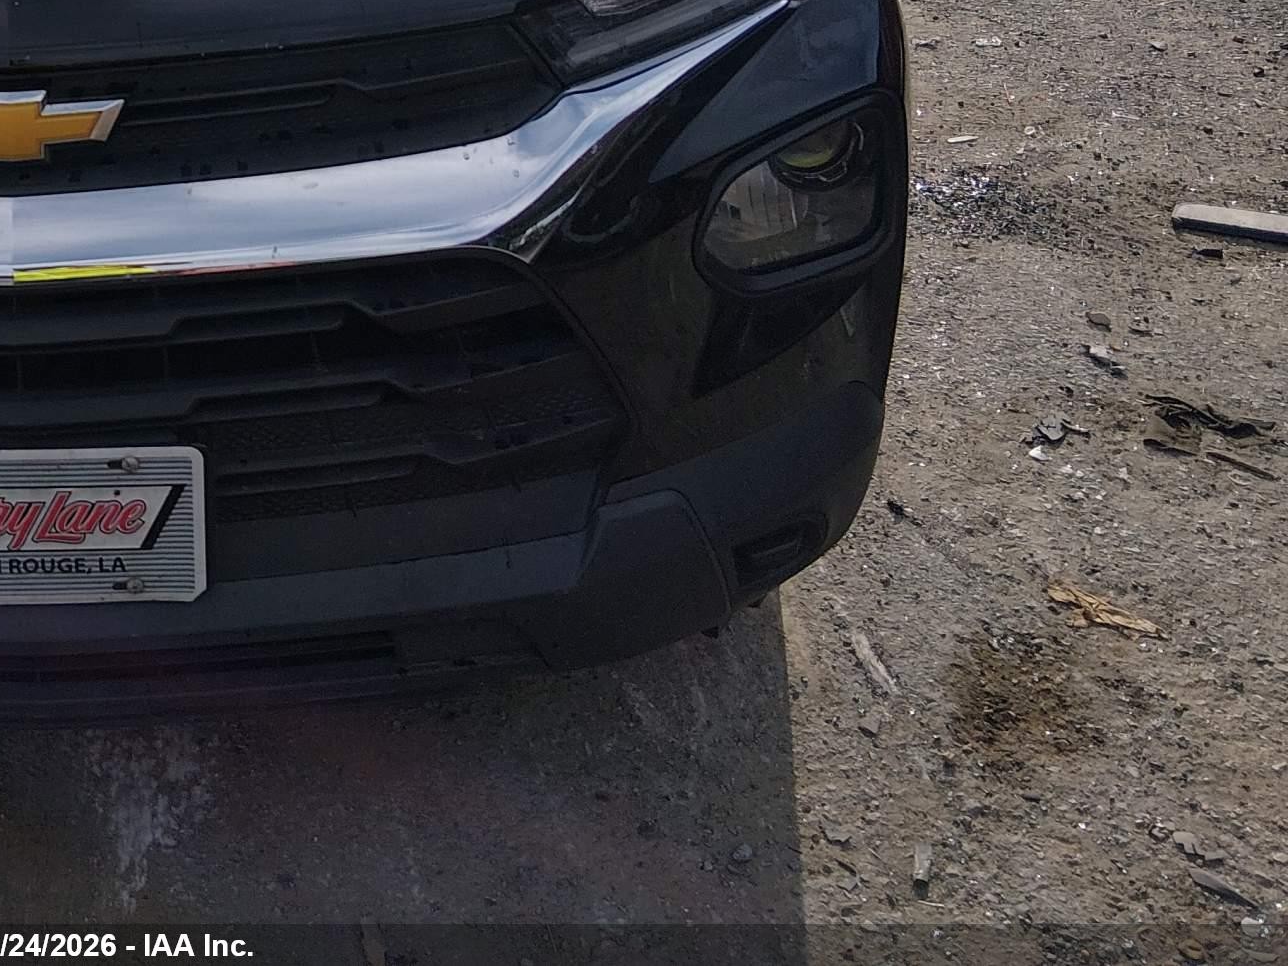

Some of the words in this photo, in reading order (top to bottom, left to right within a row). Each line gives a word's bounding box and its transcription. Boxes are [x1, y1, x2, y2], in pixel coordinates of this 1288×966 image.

[32, 490, 147, 545] Lane
[9, 557, 92, 575] ROUGE,
[98, 556, 128, 573] LA
